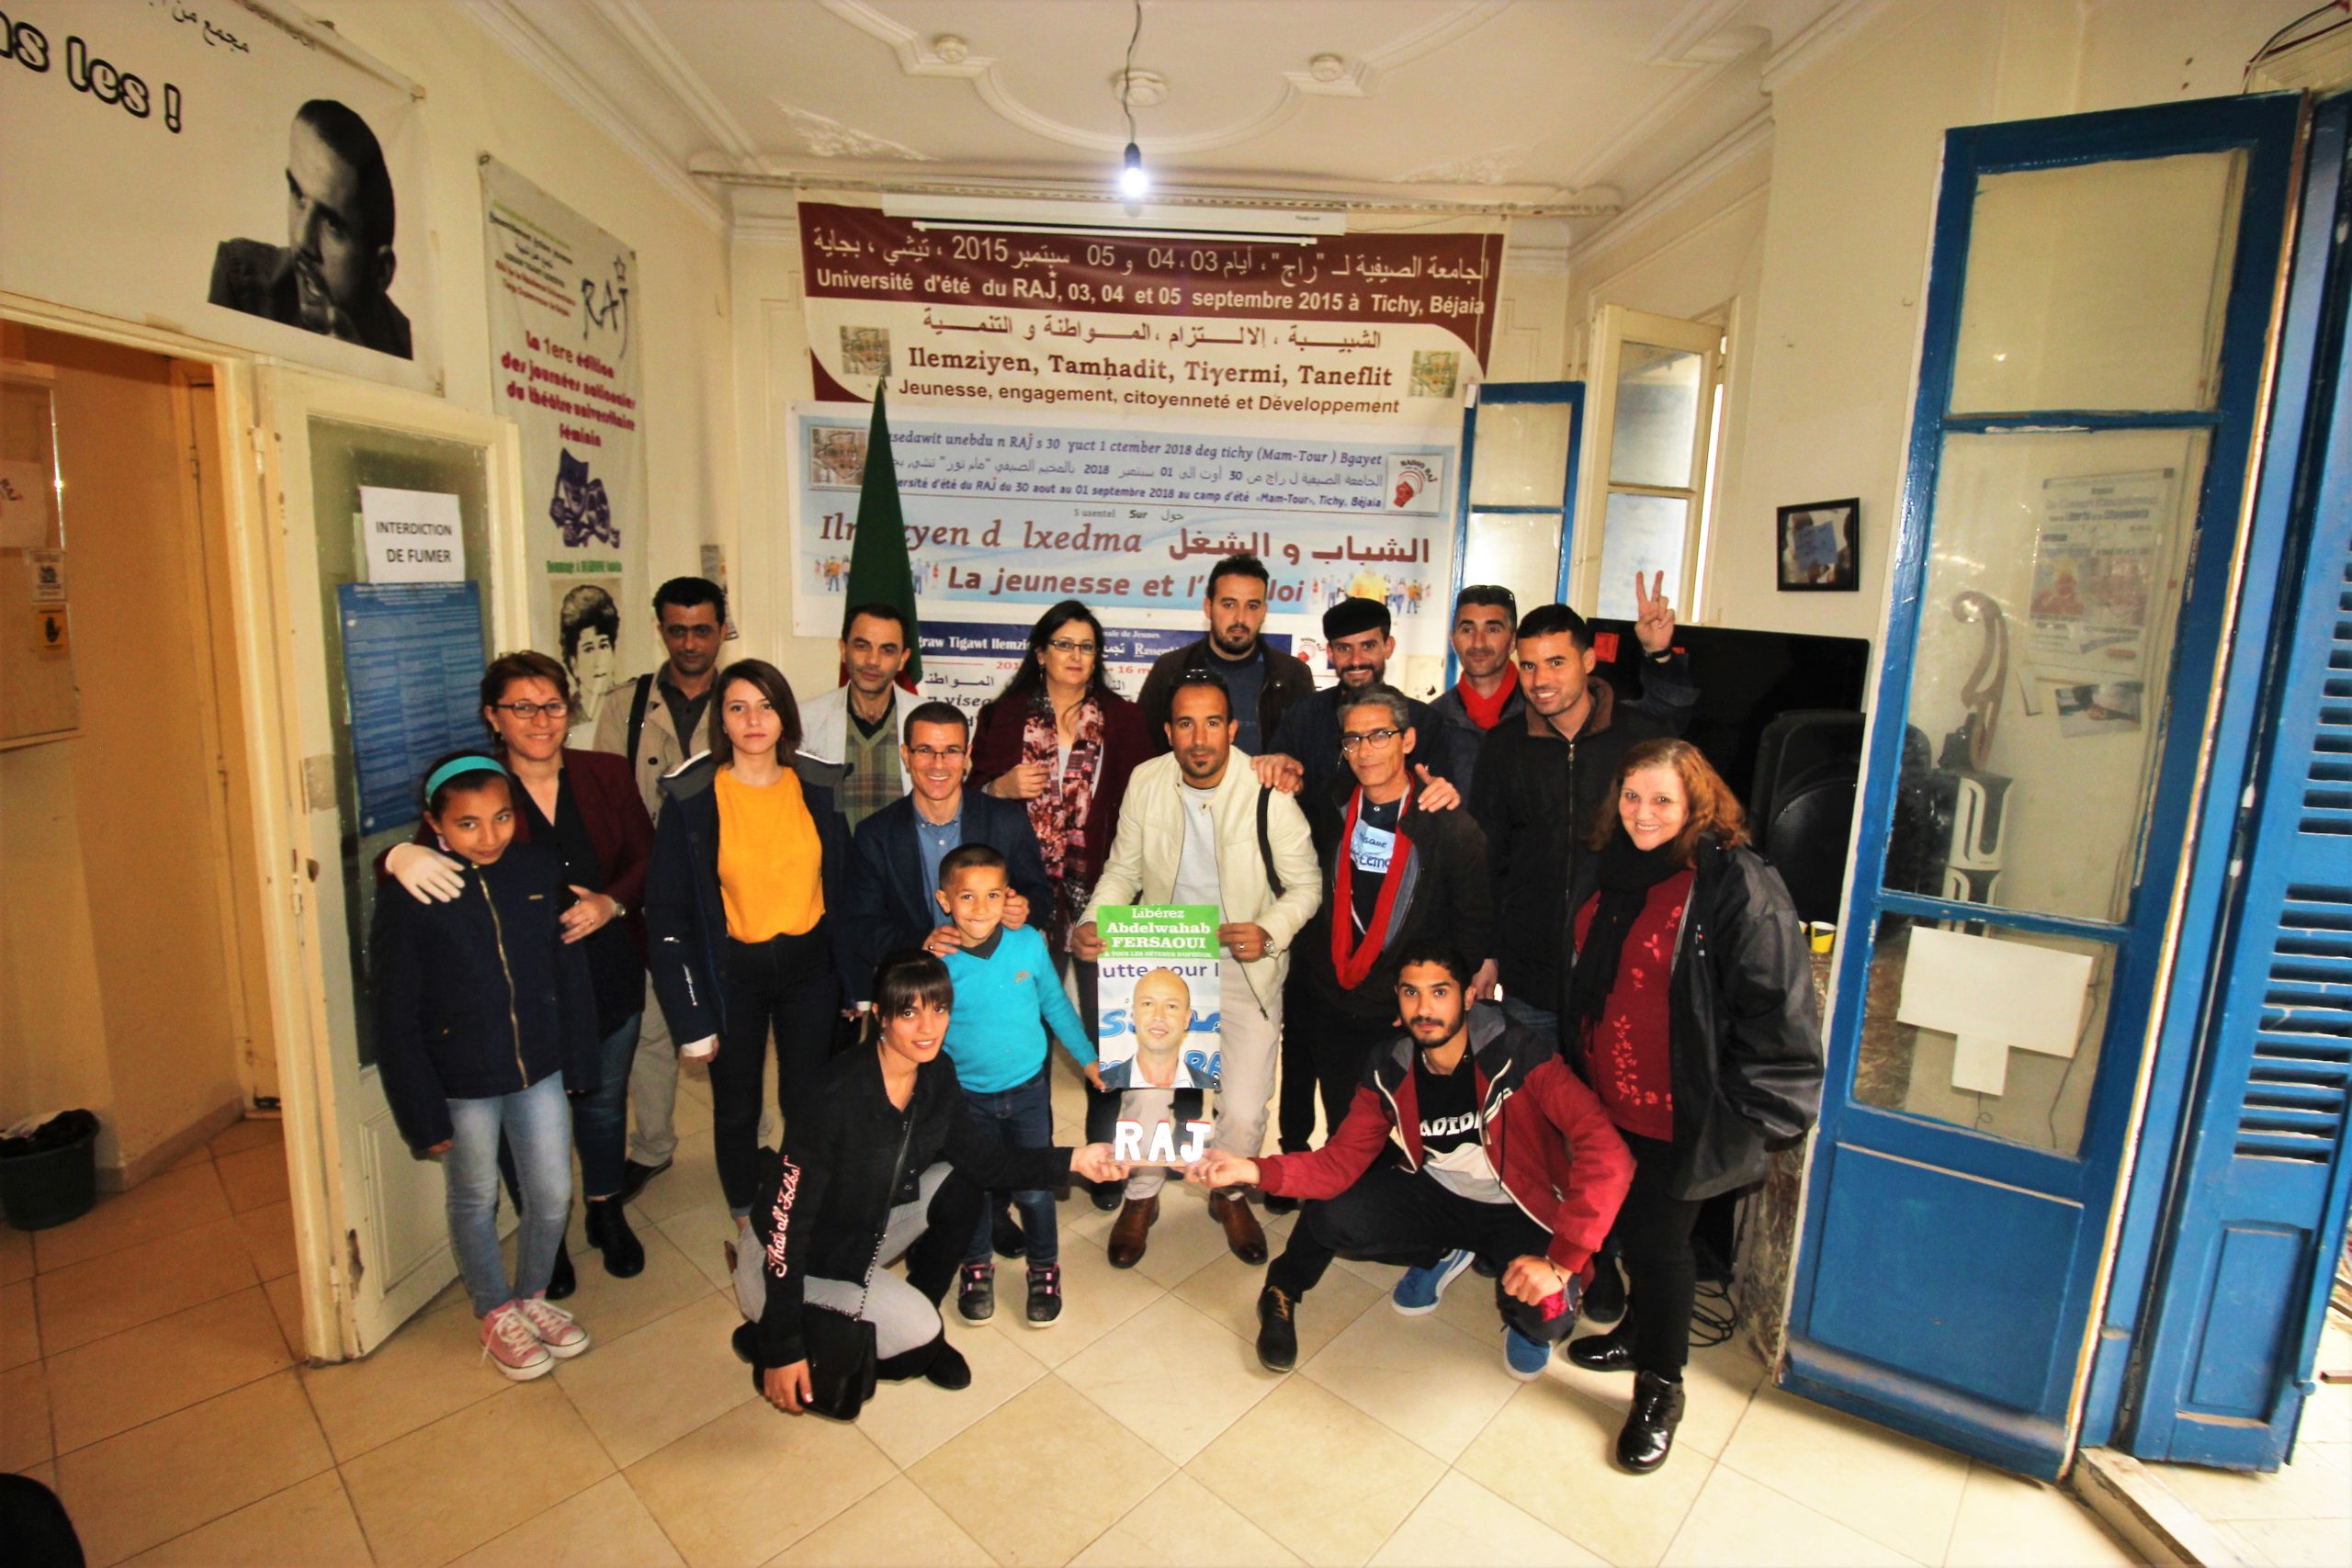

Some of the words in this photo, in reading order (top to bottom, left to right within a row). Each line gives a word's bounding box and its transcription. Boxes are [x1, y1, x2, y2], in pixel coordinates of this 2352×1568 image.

[66, 35, 150, 118] les
[813, 227, 861, 258] بجاية
[952, 235, 1009, 263] 2015
[1087, 244, 1114, 266] 05
[1011, 245, 1070, 269] سبتمبر
[1121, 260, 1133, 276] و
[1148, 248, 1175, 269] 04
[1191, 250, 1218, 272] 03
[1223, 245, 1252, 278] أيام
[1356, 254, 1422, 283] الصيفية
[1427, 255, 1489, 285] الجامعة
[816, 268, 913, 290] Université
[924, 275, 971, 294] d'été
[982, 278, 1007, 297] du
[1012, 276, 1062, 302] RAJ,
[1068, 283, 1096, 304] 03,
[1102, 285, 1124, 302] 04
[1135, 288, 1153, 304] et
[1159, 287, 1182, 305] 05
[1192, 290, 1293, 310] septembre
[1298, 291, 1343, 310] 2015
[1348, 293, 1360, 311] à
[1371, 294, 1424, 317] Tichy,
[1430, 295, 1485, 318] Béjaia
[923, 307, 1012, 335] التنمية
[1023, 323, 1035, 340] و
[1044, 315, 1150, 343] المواطنة
[543, 337, 573, 364] 1ere
[501, 351, 526, 374] des
[528, 359, 581, 391] journées
[909, 347, 1039, 376] Ilemziyen,
[1297, 364, 1393, 387] Taneflit
[507, 380, 525, 401] du
[899, 378, 992, 400] Jeunesse,
[999, 386, 1117, 404] engagement,
[1124, 390, 1230, 410] citoyenneté
[1236, 395, 1253, 409] et
[1259, 394, 1400, 414] Développement
[945, 434, 993, 447] unebdu
[997, 438, 1006, 447] n
[1009, 433, 1033, 450] RAJ
[1036, 439, 1042, 449] s
[1046, 438, 1060, 449] 30
[1164, 444, 1193, 456] 2018
[1195, 444, 1217, 460] deg
[1221, 446, 1253, 462] tichy
[1340, 452, 1382, 467] Bgayet
[1084, 464, 1110, 475] 2018
[1160, 467, 1173, 478] 01
[896, 478, 928, 489] ersité
[960, 480, 972, 491] du
[976, 478, 997, 491] RAJ
[1000, 482, 1011, 491] du
[1015, 482, 1029, 492] 30
[1033, 484, 1056, 494] aout
[1059, 486, 1071, 494] au
[1075, 485, 1088, 495] 01
[1091, 487, 1146, 498] septembre
[1149, 488, 1174, 499] 2018
[1178, 491, 1190, 499] au
[1193, 492, 1221, 502] camp
[1129, 510, 1148, 519] Sur
[376, 521, 452, 536] INTERDICTION
[981, 519, 1001, 547] d
[1023, 521, 1142, 553] lxedma
[386, 548, 404, 563] DE
[408, 549, 452, 563] FUMER
[1169, 528, 1270, 561] الشغل
[1283, 542, 1300, 566] و
[1312, 535, 1430, 566] الشباب
[948, 566, 981, 590] La
[989, 567, 1130, 595] jeunesse
[1142, 574, 1173, 597] et
[948, 637, 988, 651] Tigawt
[1131, 907, 1185, 919] Libérez
[1106, 921, 1211, 934] Abdelwahab
[1112, 937, 1206, 949] FERSAOUI
[1114, 1118, 1212, 1163] RAJ
[772, 1205, 789, 1231] all
